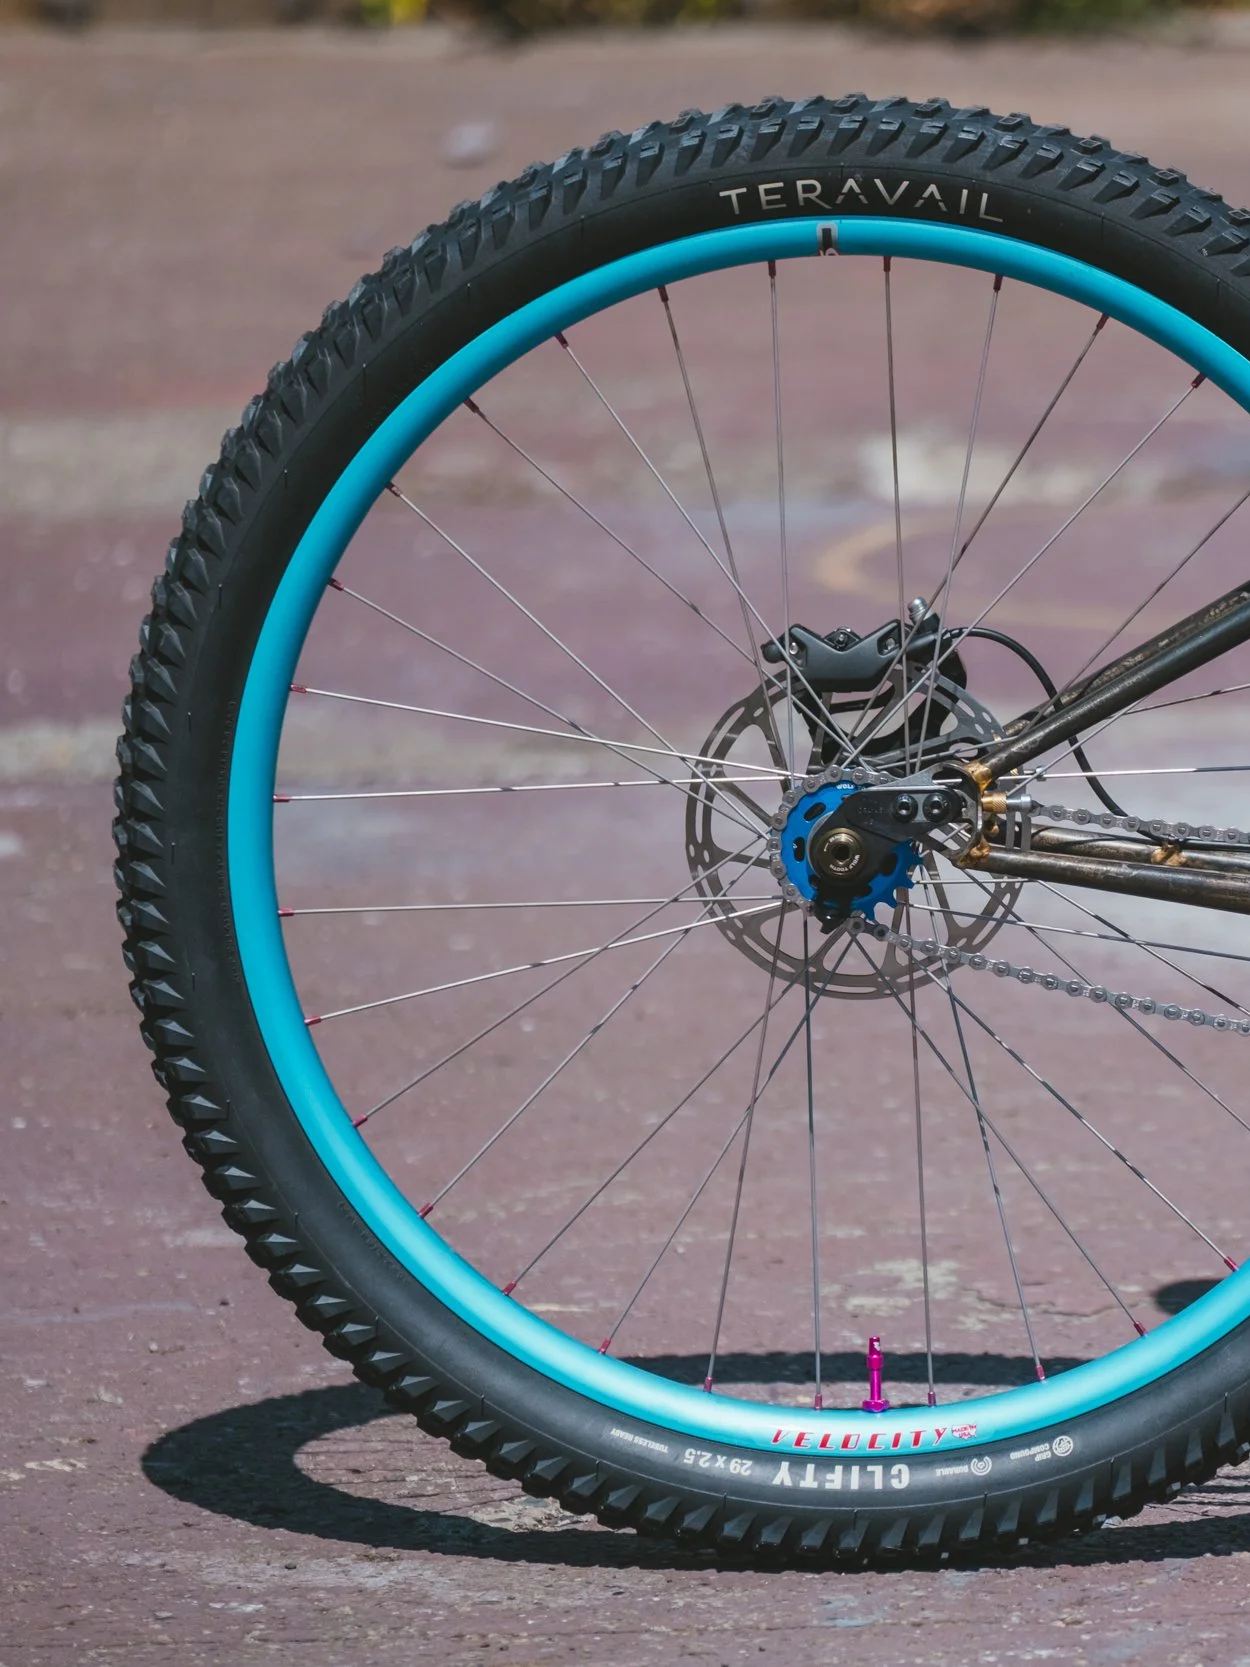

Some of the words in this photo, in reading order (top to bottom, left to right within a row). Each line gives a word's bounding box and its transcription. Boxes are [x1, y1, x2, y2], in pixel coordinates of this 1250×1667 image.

[718, 178, 1004, 223] TERAVAIL
[609, 1427, 634, 1443] READY
[633, 1435, 670, 1454] TUBELESS
[770, 1426, 948, 1450] VELOCITY
[682, 1447, 713, 1469] 2.5
[1009, 1442, 1051, 1460] COMPOUND
[1034, 1450, 1052, 1462] GRIP
[715, 1454, 728, 1470] x
[729, 1456, 753, 1477] 29
[935, 1464, 969, 1477] DURABLE
[771, 1460, 911, 1490] CLIFTY
